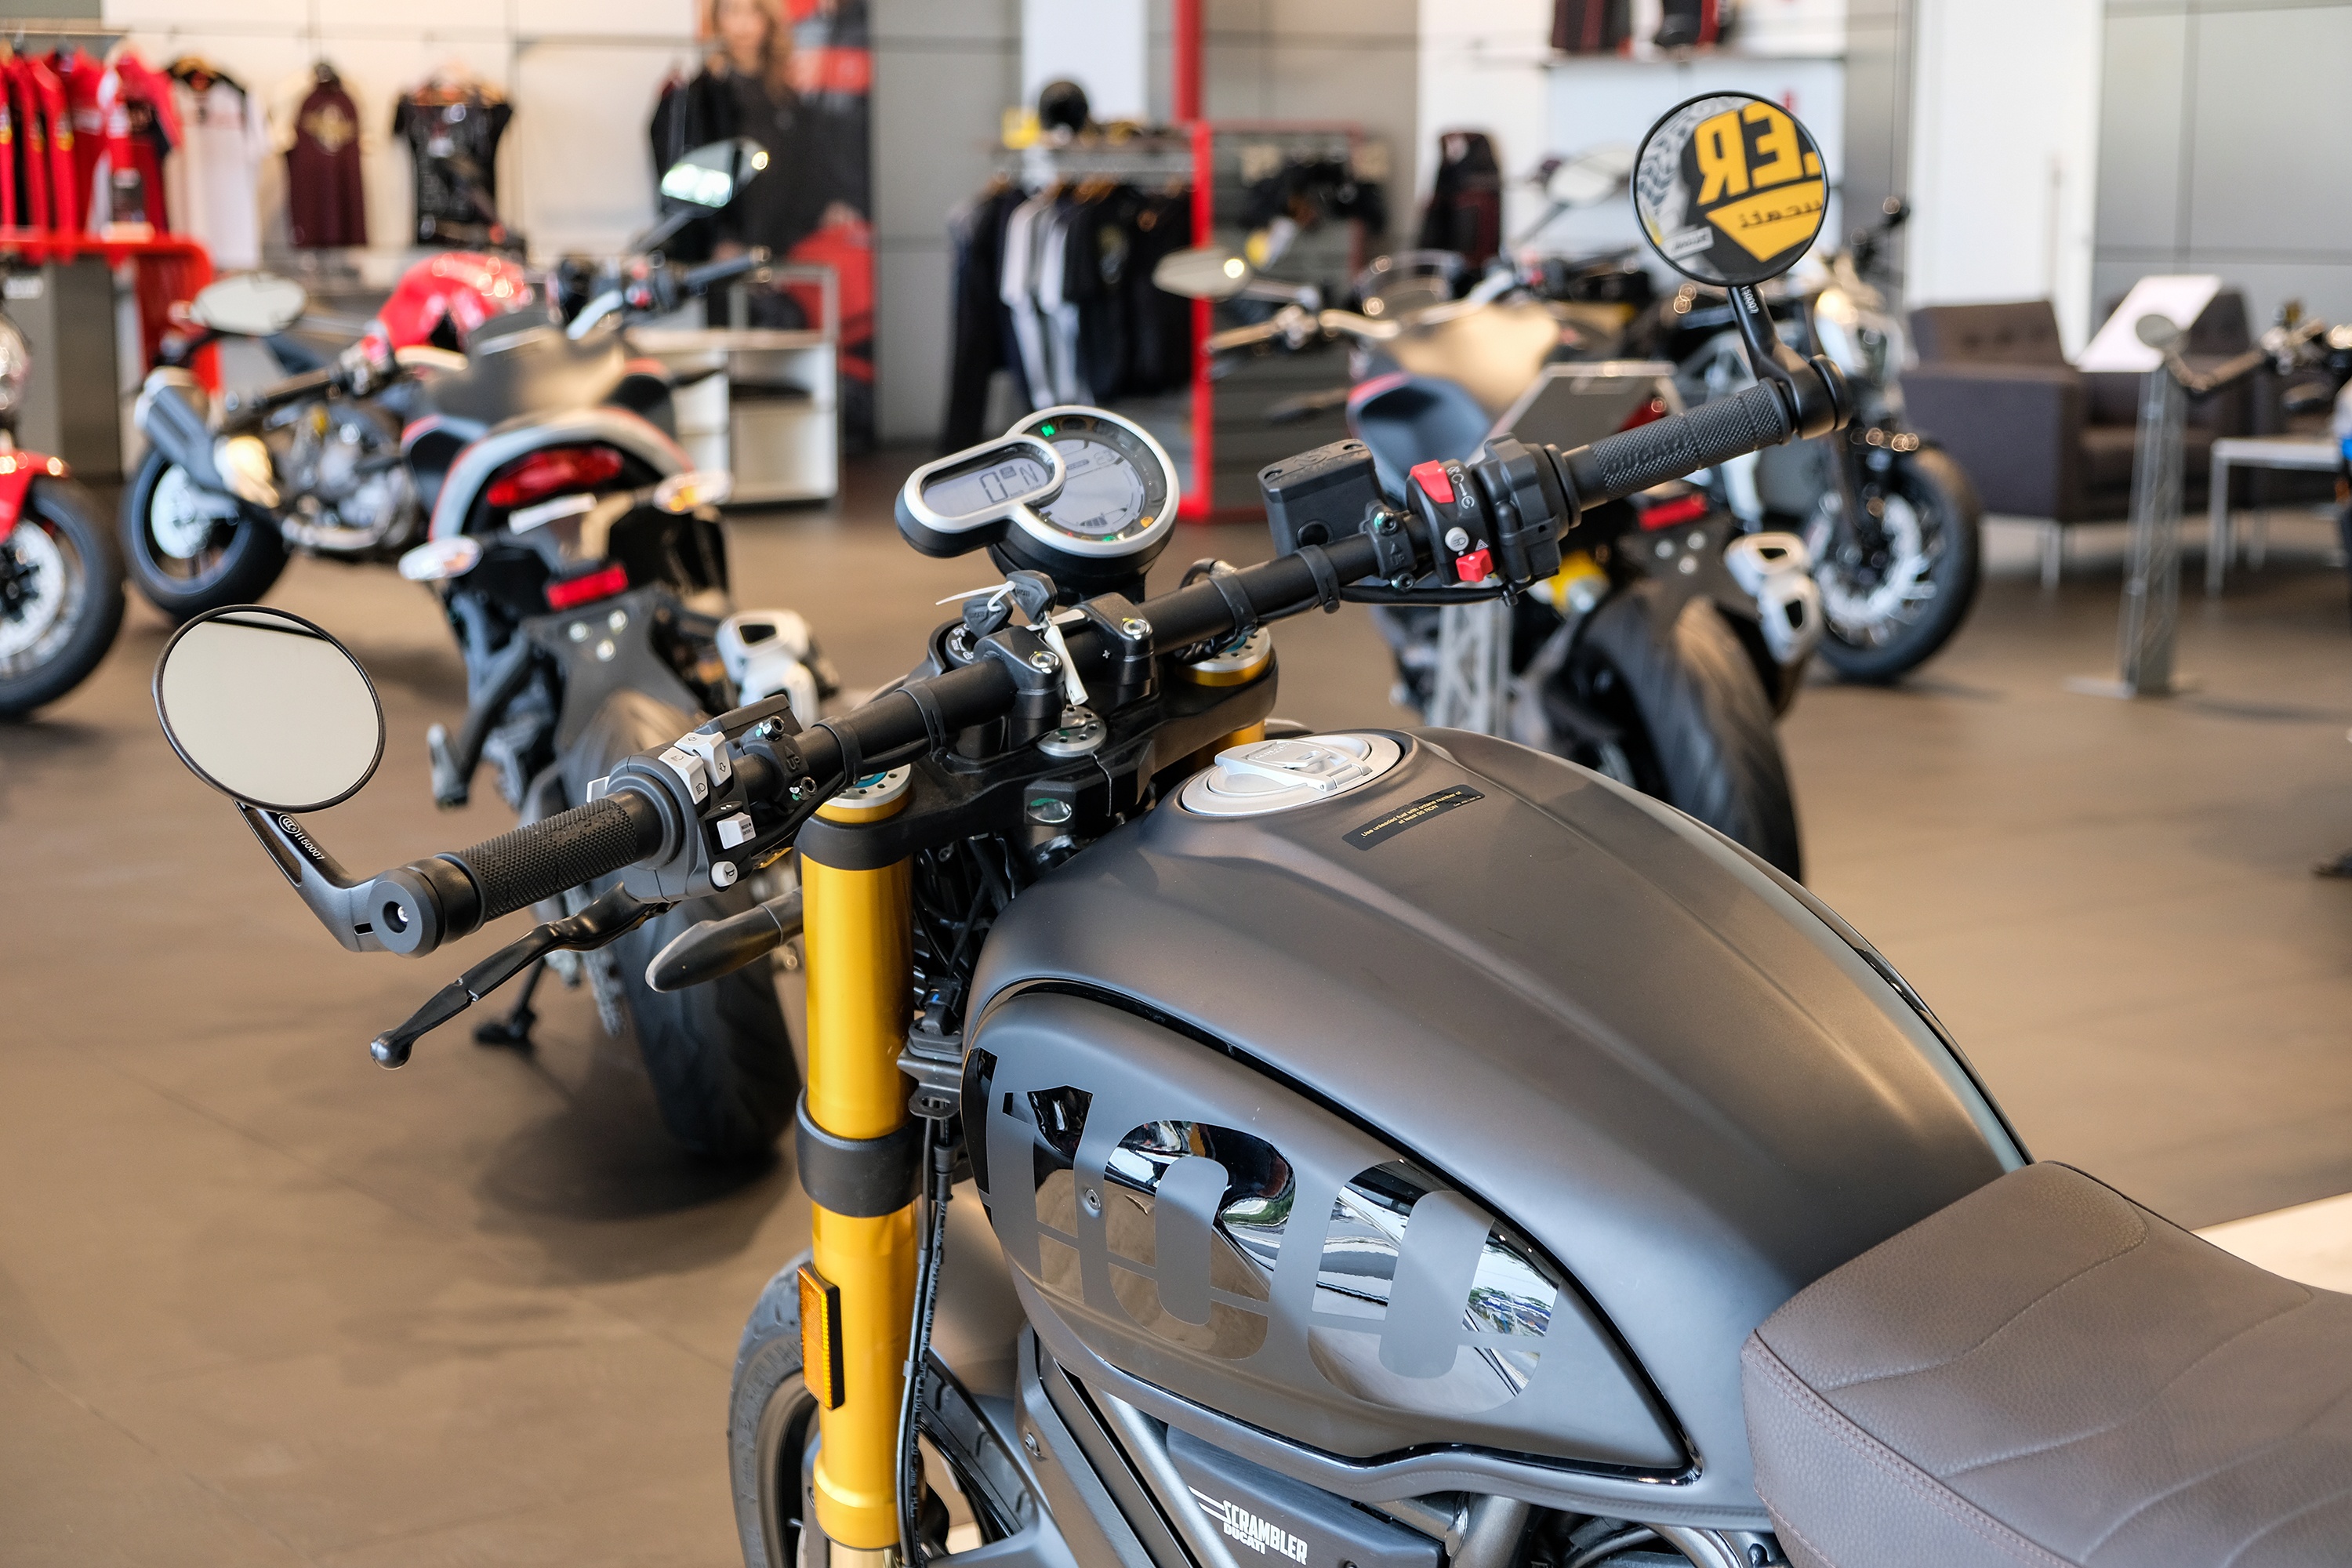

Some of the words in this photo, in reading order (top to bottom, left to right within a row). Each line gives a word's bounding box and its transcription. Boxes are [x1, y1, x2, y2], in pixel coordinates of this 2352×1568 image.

[980, 471, 1008, 503] 0
[1019, 463, 1039, 485] N
[786, 756, 800, 771] UP
[1425, 804, 1439, 814] RON
[1361, 829, 1374, 837] Use
[1223, 1500, 1308, 1566] SCRAMBLER
[1223, 1522, 1266, 1555] DUCATI
